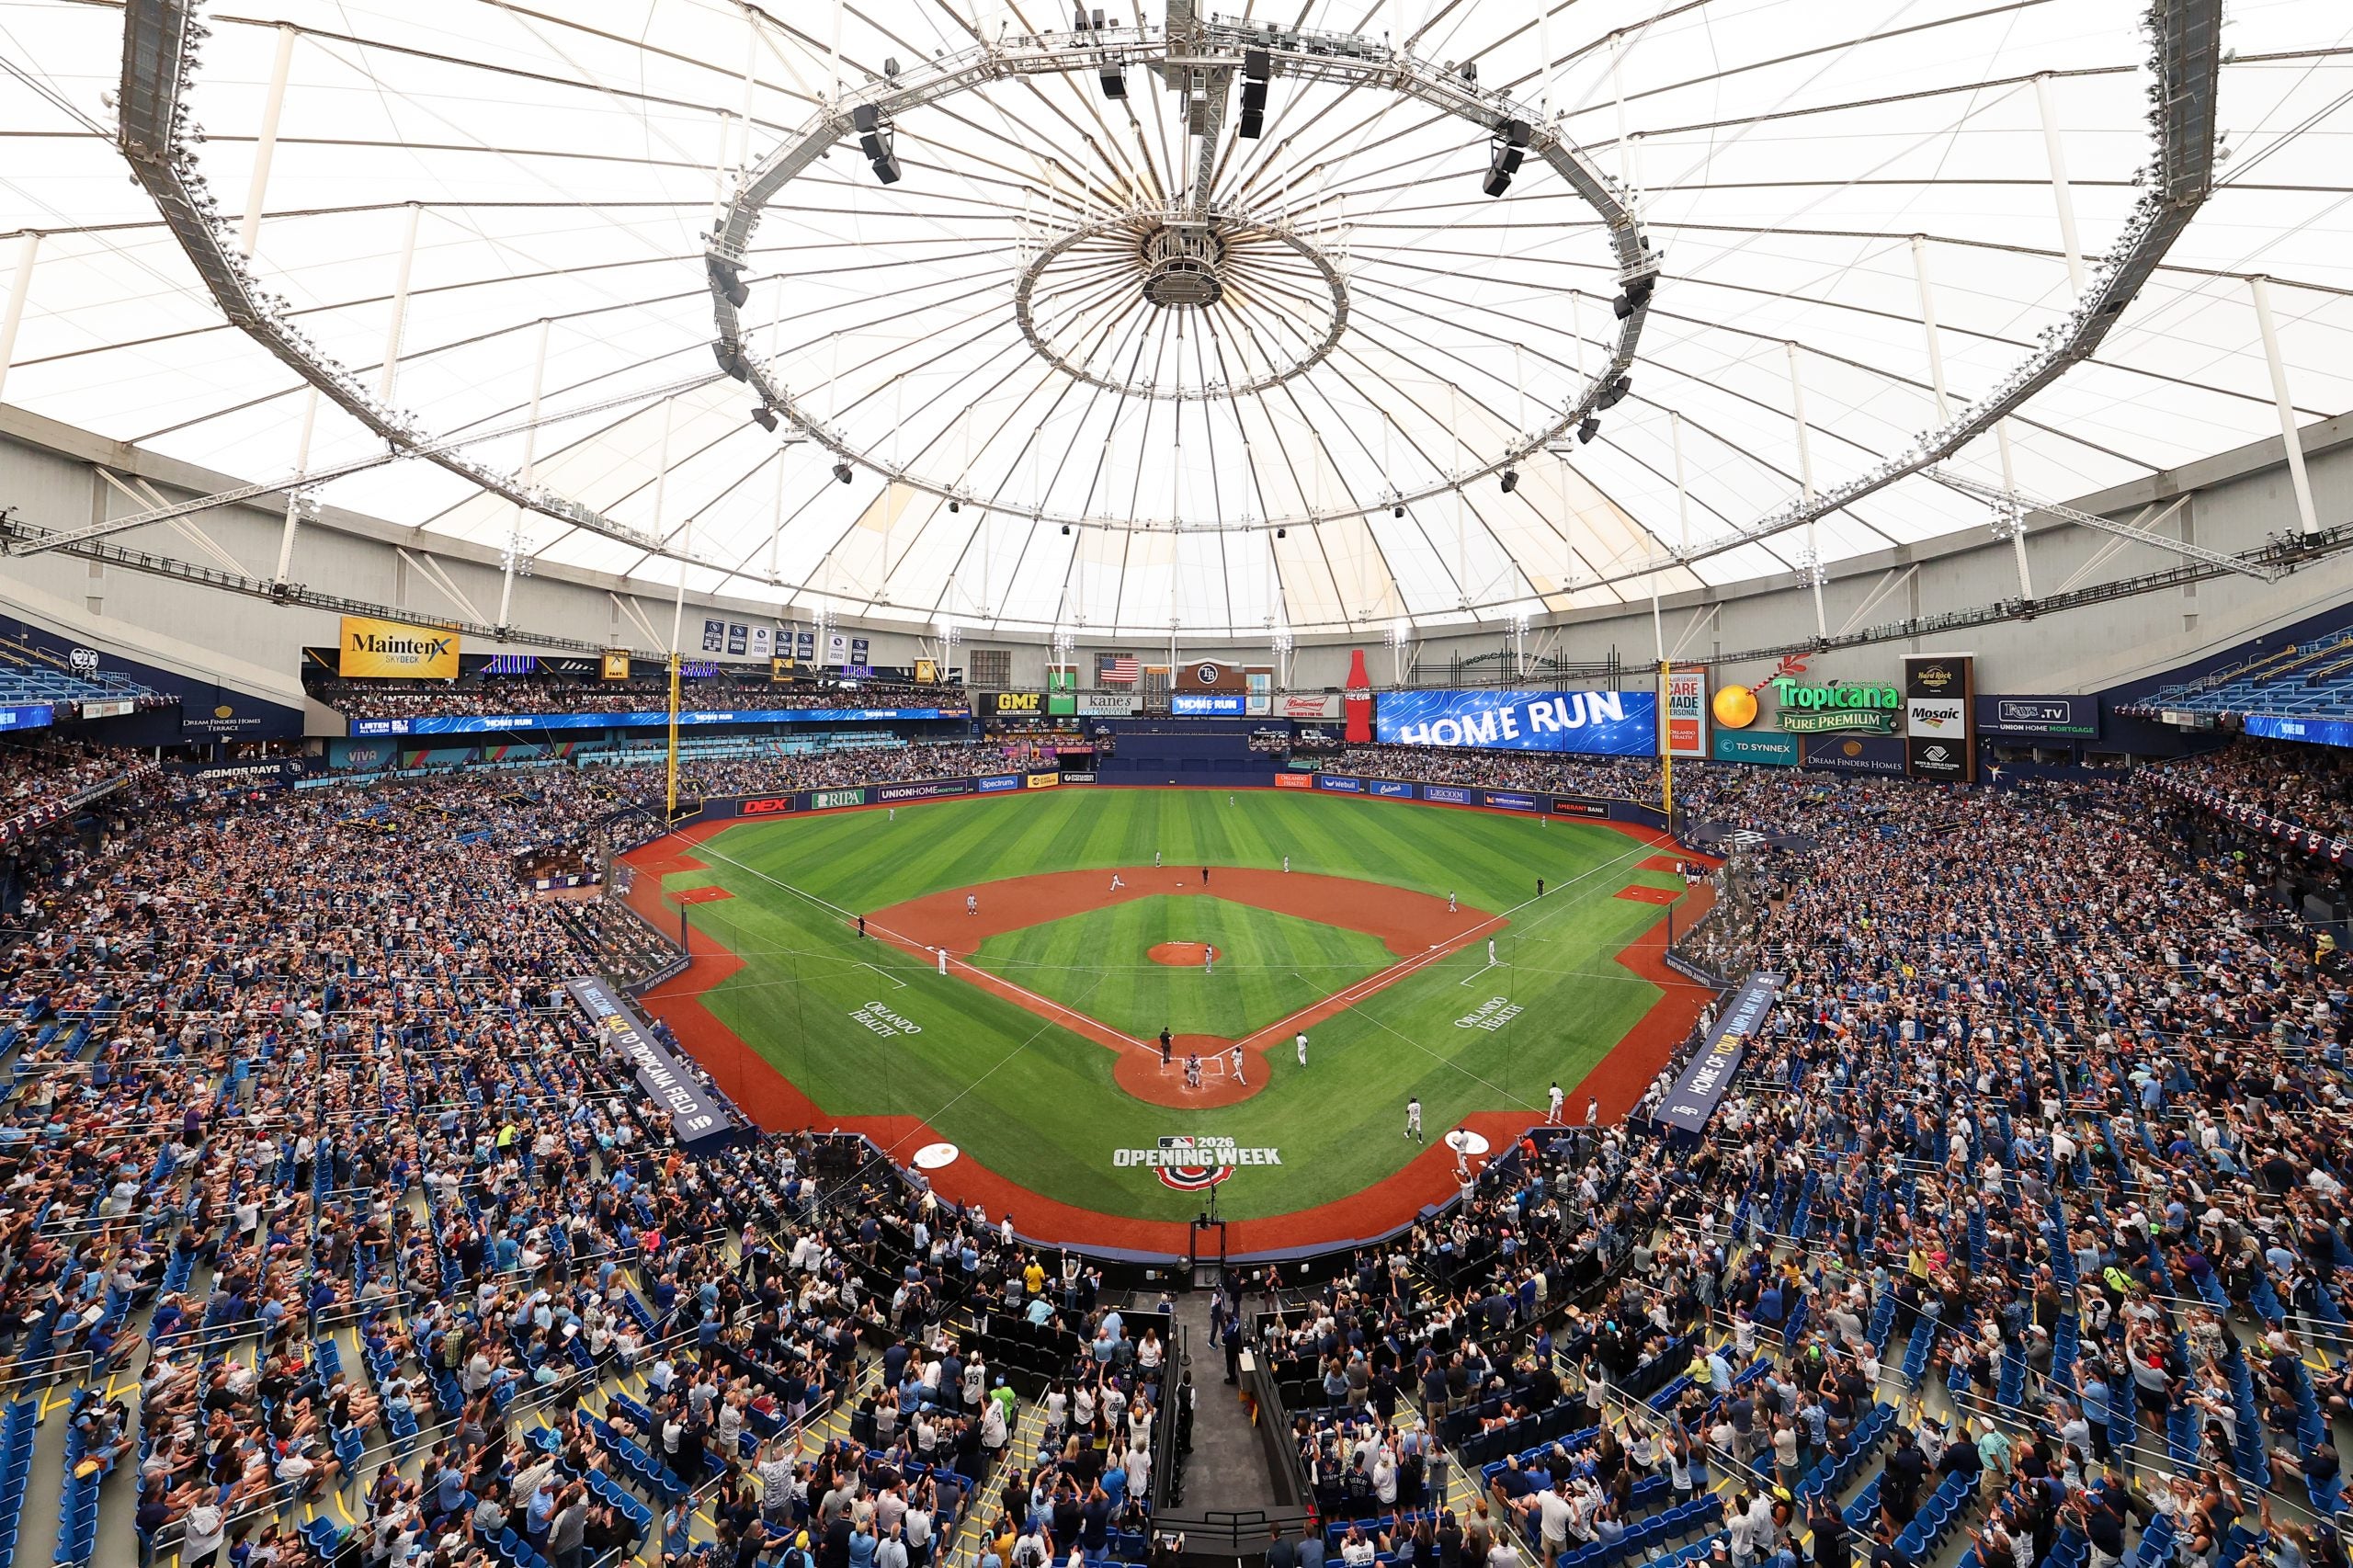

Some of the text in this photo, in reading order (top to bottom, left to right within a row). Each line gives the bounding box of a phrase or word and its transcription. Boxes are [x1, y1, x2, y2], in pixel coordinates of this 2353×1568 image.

[351, 632, 452, 661] MaintenX
[73, 652, 83, 665] 42
[1200, 667, 1215, 680] TB
[1918, 671, 1952, 680] Hard Rock
[1772, 677, 1900, 710] Tropicana
[998, 694, 1040, 710] GMF
[1177, 698, 1237, 709] HOME RUN
[1289, 699, 1324, 707] Budweiser
[1401, 690, 1627, 746] HOME RUN
[1912, 707, 1960, 719] Mosaic
[183, 719, 209, 727] DREAM
[359, 722, 390, 730] LISTEN
[485, 719, 512, 728] HOME
[1784, 713, 1880, 729] PURE PREMIUM
[1736, 742, 1790, 754] TD SYNNEX
[348, 750, 378, 762] VIVA
[1808, 756, 1902, 770] DREAM FINDERS HOMES
[203, 767, 249, 779] SOMOS
[982, 778, 1012, 790] Spectrum
[1335, 781, 1356, 790] Webull
[829, 791, 860, 806] RIPA
[881, 788, 913, 799] UNION
[912, 785, 938, 797] HOME
[744, 798, 787, 813] DEX
[1556, 802, 1587, 812] AMERANT
[644, 960, 689, 992] RAYMOND JAMES
[1666, 959, 1711, 987] RAYMOND JAMES
[864, 1001, 923, 1034] ORLANDO
[1454, 996, 1508, 1028] ORLANDO
[1476, 1004, 1525, 1032] HEALTH
[847, 1008, 898, 1039] HEALTH
[1687, 987, 1768, 1096] HOME OF YOUR TAMPA BAY RAYS
[582, 986, 699, 1115] WELCOME BACK TO TROPICANA FIELD
[1197, 1136, 1235, 1148] 2026
[1113, 1147, 1282, 1167] OPENING WEEK
[1398, 1332, 1406, 1341] 13
[969, 1375, 979, 1385] 13
